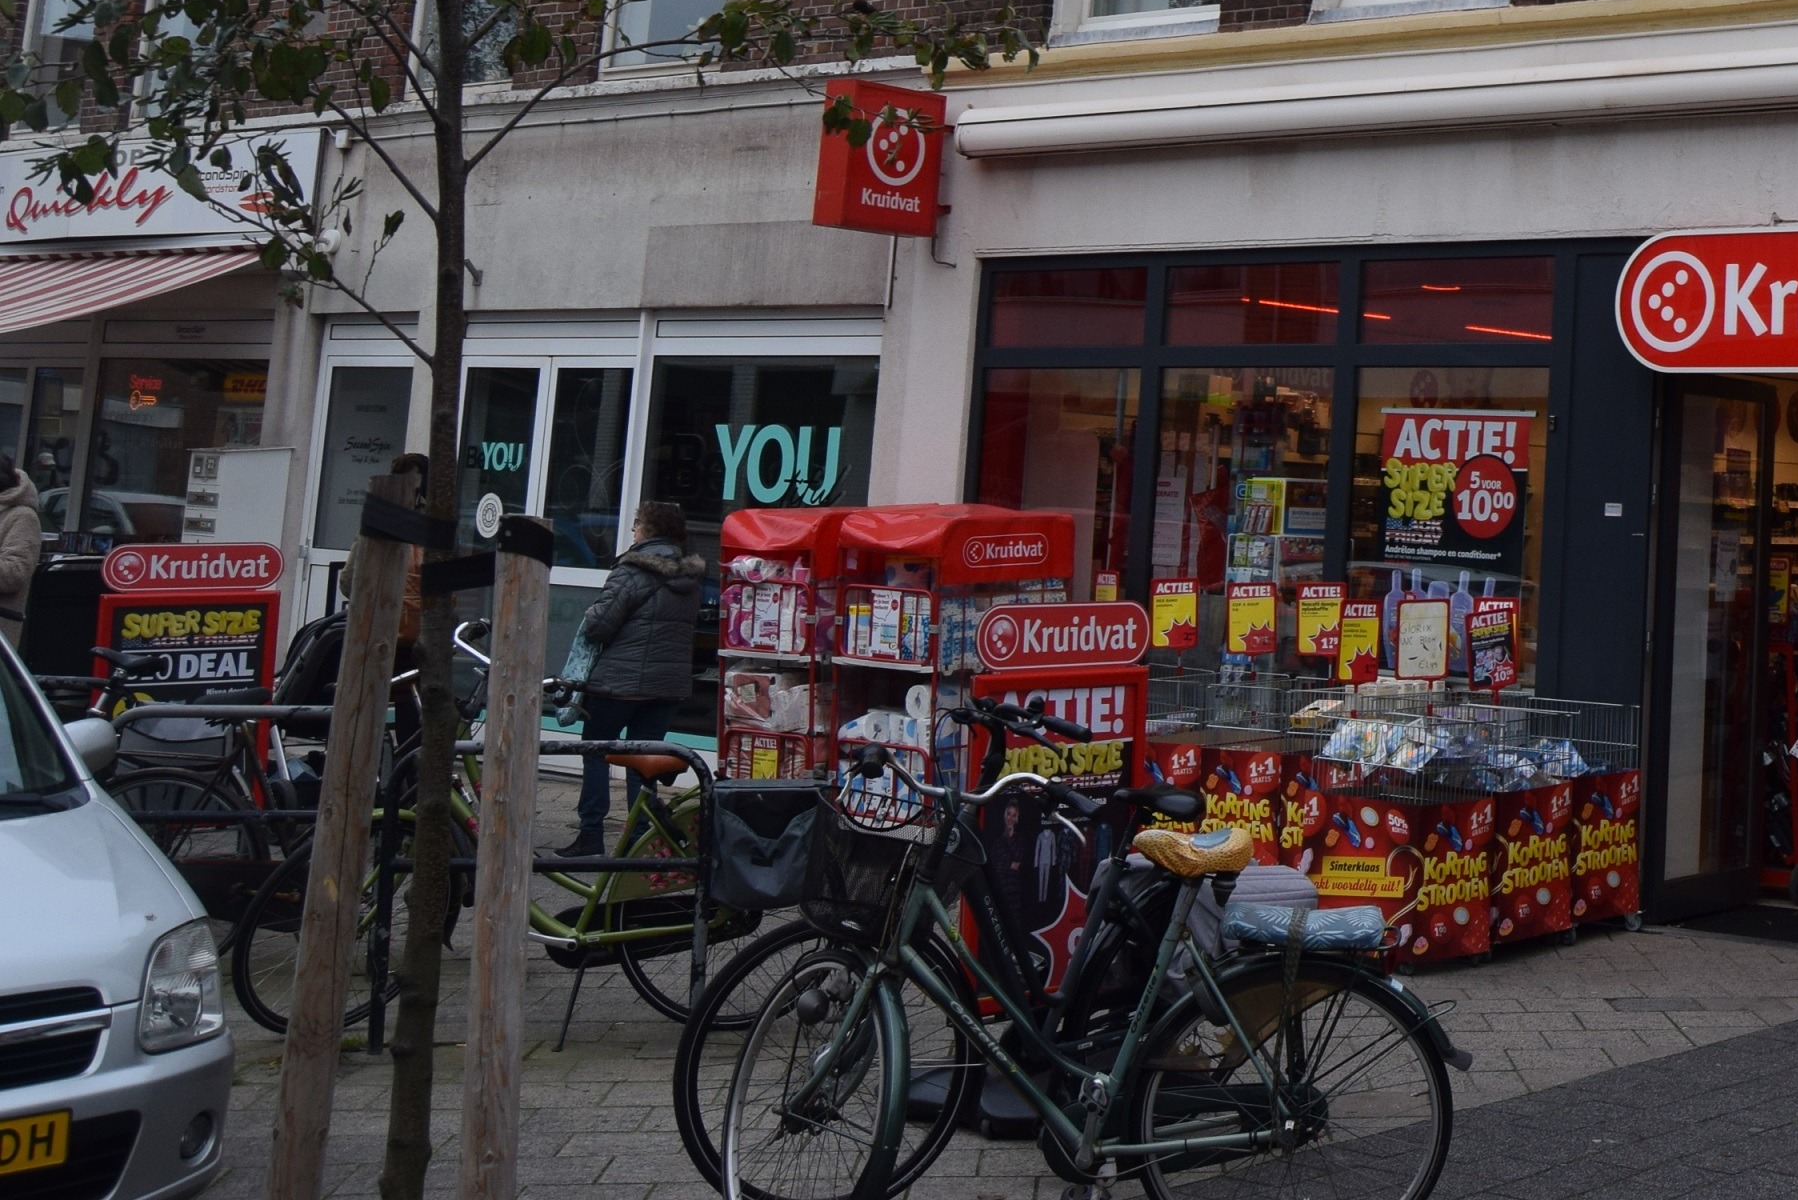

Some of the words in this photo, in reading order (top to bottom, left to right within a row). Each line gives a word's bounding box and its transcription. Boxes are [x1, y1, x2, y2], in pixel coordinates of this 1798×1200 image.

[6, 167, 173, 233] Quickly
[861, 187, 920, 213] Kruidvat
[130, 374, 162, 390] Service
[1393, 418, 1517, 465] ACTIE!
[481, 441, 524, 472] YOU
[715, 424, 841, 506] YOU
[1384, 457, 1457, 493] SUPER
[1470, 471, 1480, 489] 5
[1481, 479, 1502, 490] VOOR
[1388, 488, 1446, 521] SIZE
[1457, 489, 1514, 523] 10.00
[986, 540, 1043, 560] Kruidvat
[1385, 530, 1443, 545] FRIDAY
[1416, 547, 1447, 557] shampoo
[150, 553, 270, 580] Kruidvat
[1097, 574, 1117, 585] ACTIE!
[1156, 582, 1193, 593] ACTIE!
[1232, 585, 1271, 597] ACTIE!
[1301, 586, 1341, 598] ACTIE!
[1344, 604, 1377, 617] ACTIE!
[1478, 601, 1514, 612] ACTIE!
[121, 610, 201, 639] SUPER
[202, 609, 262, 636] SIZE
[1471, 612, 1507, 628] ACTIE!
[193, 634, 259, 646] FRIDAY
[1022, 616, 1138, 654] Kruidvat
[178, 651, 255, 680] DEAL
[754, 737, 777, 749] ACTIE!
[997, 741, 1069, 777] SUPER
[1070, 740, 1125, 776] SIZE
[1171, 749, 1197, 769] 1+1
[1249, 757, 1276, 777] 1+1
[1062, 772, 1122, 789] FRIDAY
[1621, 774, 1639, 799] 1+1
[1206, 791, 1270, 819] KORTING
[1304, 796, 1319, 817] +1
[1551, 787, 1571, 813] 1+1
[1470, 803, 1493, 830] 1+1
[1201, 818, 1274, 844] STROOEN
[1581, 819, 1635, 850] KORTING
[1508, 833, 1567, 867] KORTING
[1576, 842, 1637, 876] STROOIEN
[1329, 861, 1380, 873] Sinterklaas
[1424, 851, 1487, 883] KORTING
[1501, 857, 1569, 894] STROOIEN
[1313, 879, 1329, 890] akt
[1331, 878, 1378, 895] voordelig
[1380, 880, 1400, 892] uit!
[1416, 877, 1489, 912] STROOIEN
[983, 895, 1011, 957] GAZELLE
[1130, 976, 1158, 1034] Gazelle
[950, 1000, 1009, 1062] Gazelle
